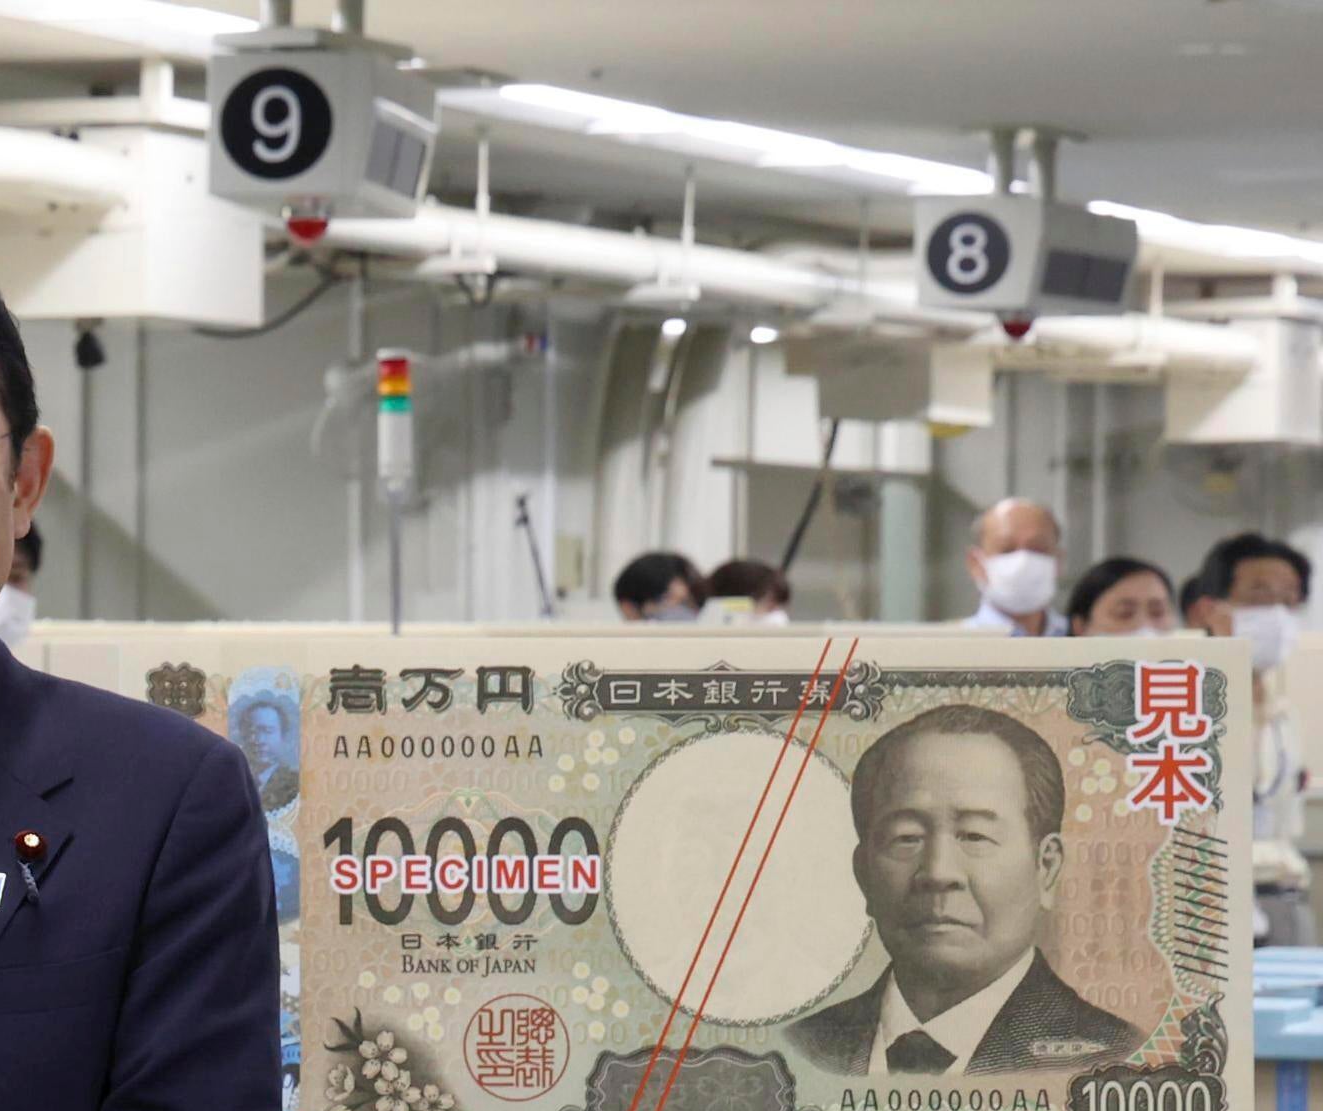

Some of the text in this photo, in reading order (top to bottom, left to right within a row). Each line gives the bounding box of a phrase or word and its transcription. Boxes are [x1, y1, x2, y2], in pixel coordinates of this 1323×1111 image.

[252, 84, 302, 163] 9
[946, 220, 988, 284] 8
[609, 680, 835, 706] 日本銀行券
[333, 735, 543, 758] AA000000AA
[1131, 662, 1211, 821] 見本
[324, 817, 600, 926] 10000
[331, 857, 600, 892] SPECIMEN
[401, 934, 538, 951] 日本銀行
[840, 1088, 1053, 1111] AA000000AA
